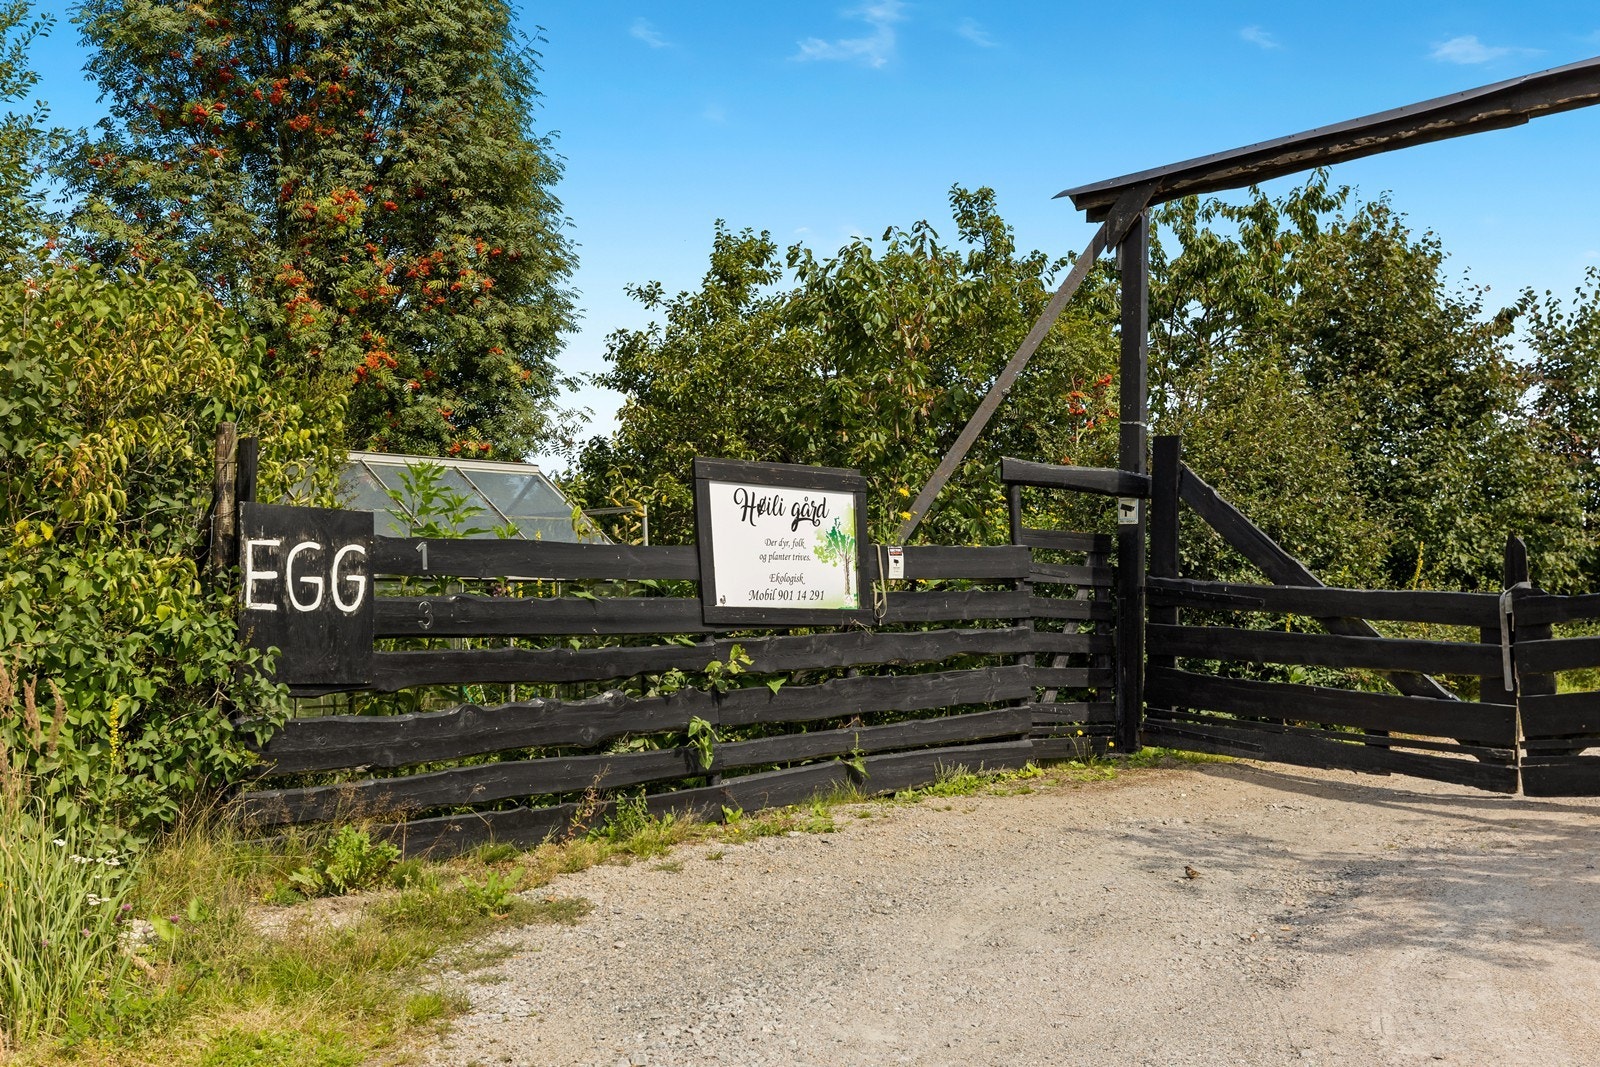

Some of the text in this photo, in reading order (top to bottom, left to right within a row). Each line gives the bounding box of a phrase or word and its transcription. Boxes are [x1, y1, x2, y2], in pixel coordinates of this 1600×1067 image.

[791, 496, 830, 532] gård
[765, 538, 806, 549] Der dyr, folk
[415, 541, 428, 570] 1
[759, 551, 811, 563] og planter trives.
[246, 539, 366, 612] EGG
[769, 573, 806, 585] Ekologisk
[748, 588, 825, 601] Mobil 901 14 291
[418, 601, 434, 630] 3
